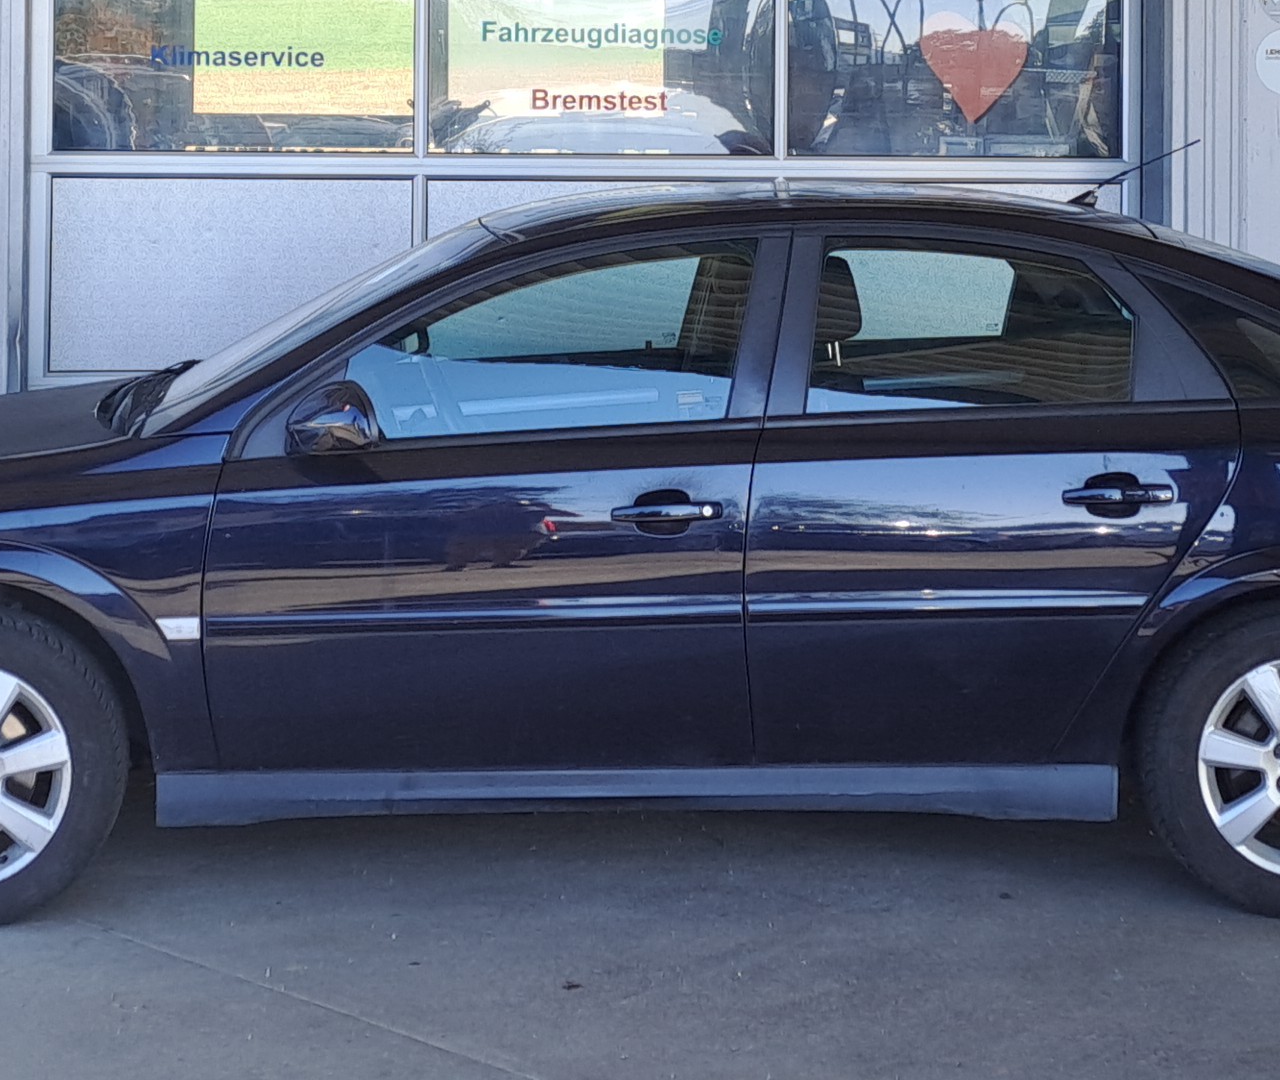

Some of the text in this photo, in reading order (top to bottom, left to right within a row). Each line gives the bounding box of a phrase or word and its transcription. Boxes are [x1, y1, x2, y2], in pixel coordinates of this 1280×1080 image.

[481, 20, 724, 50] Fahrzeugdiagnose
[150, 44, 326, 67] Klimaservice
[530, 88, 669, 112] Bremstest
